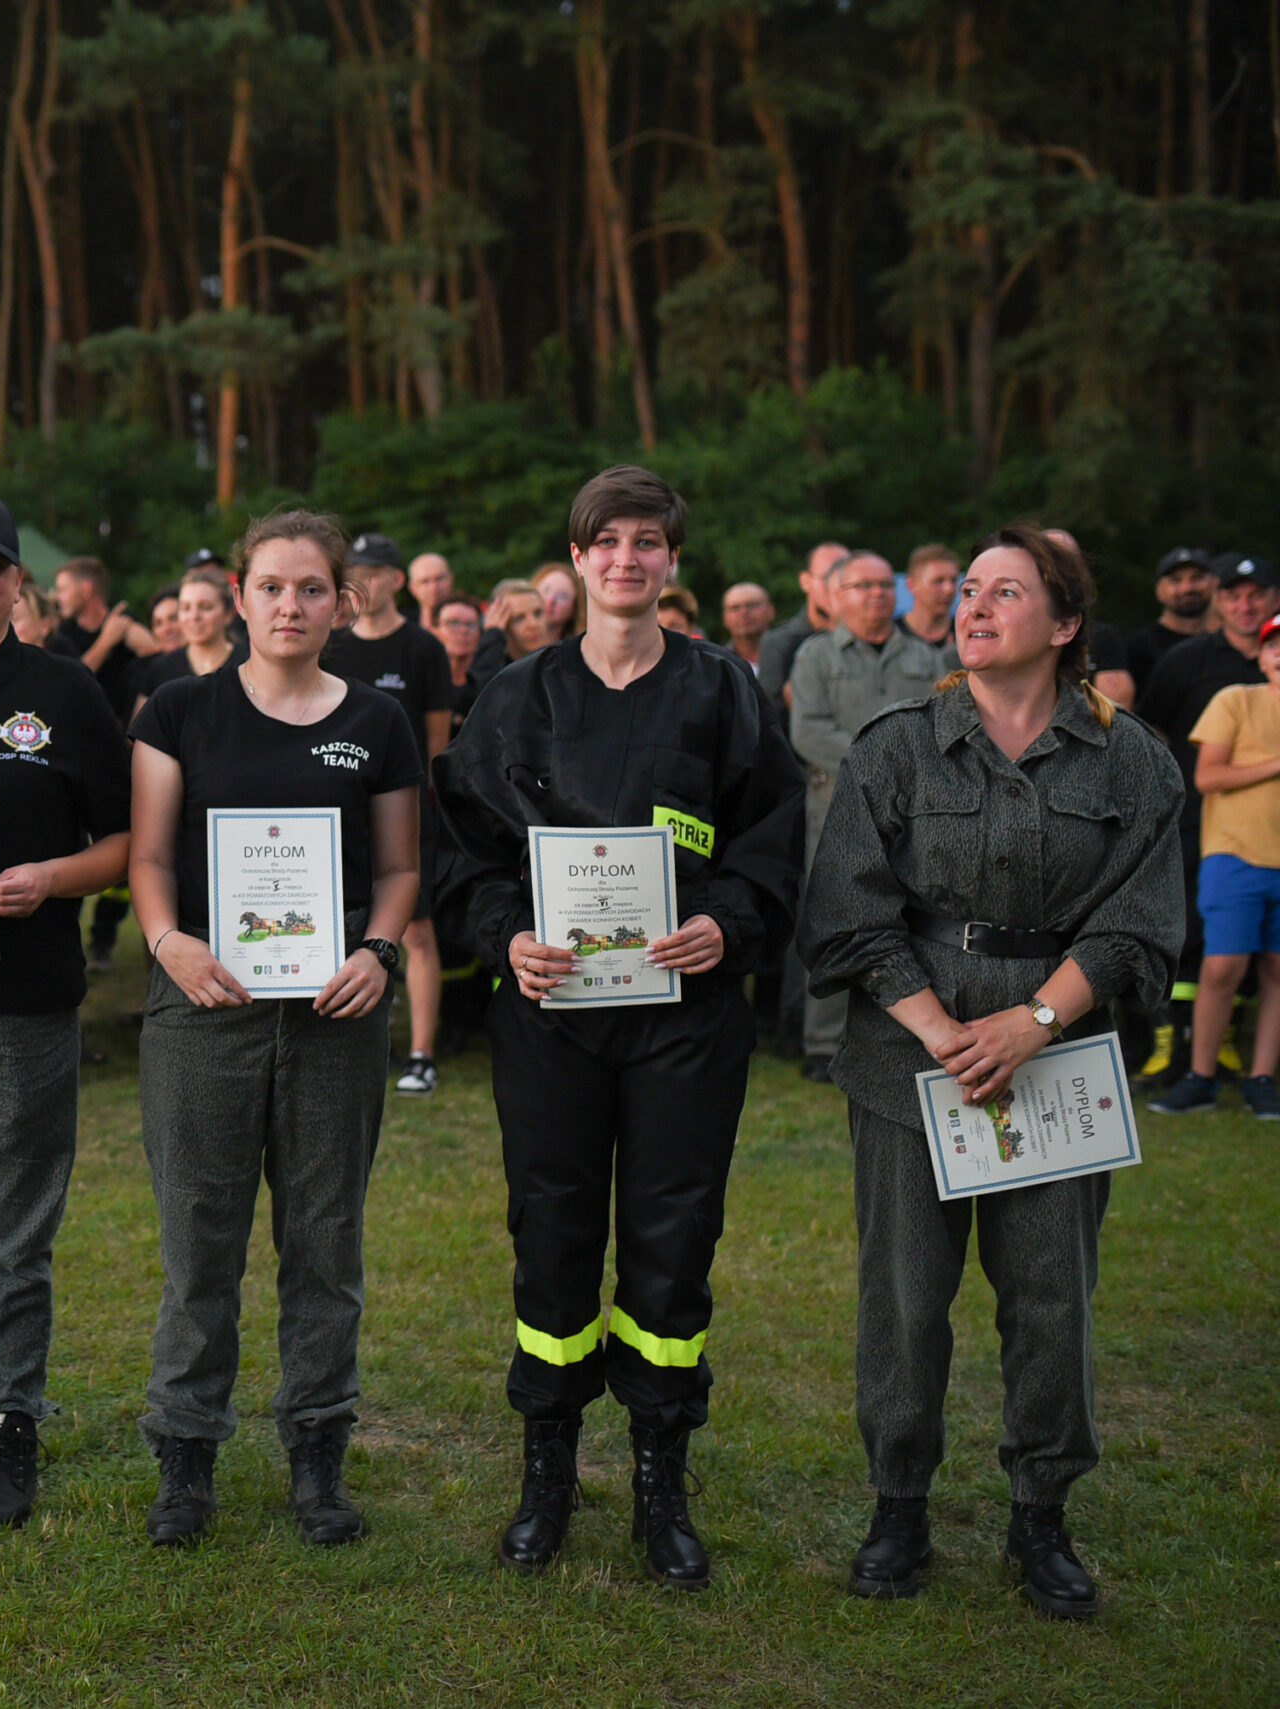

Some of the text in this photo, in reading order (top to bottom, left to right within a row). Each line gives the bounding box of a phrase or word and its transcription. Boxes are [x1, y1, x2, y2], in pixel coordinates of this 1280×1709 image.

[311, 742, 370, 762] KASZCZOR
[19, 753, 49, 766] REKLIN
[323, 754, 359, 770] TEAM
[244, 845, 306, 858] DYPLOM
[568, 864, 635, 877] DYPLOM
[1072, 1077, 1095, 1139] DYPLOM
